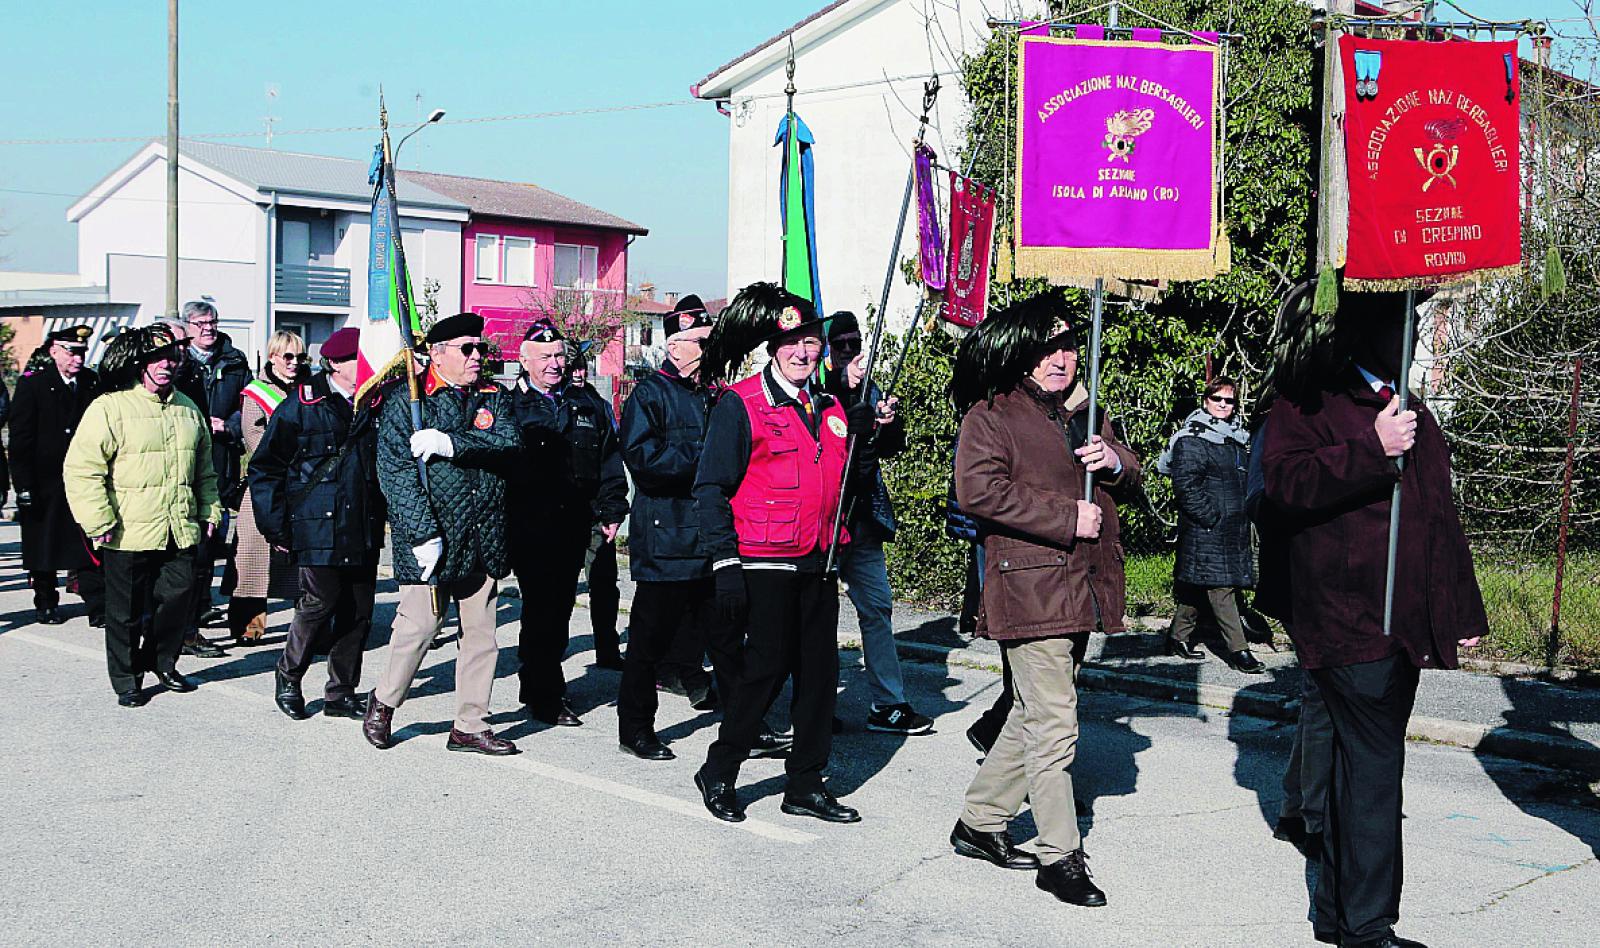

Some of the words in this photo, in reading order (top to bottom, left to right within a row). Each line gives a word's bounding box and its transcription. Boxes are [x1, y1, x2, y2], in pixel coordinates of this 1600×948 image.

[1038, 75, 1112, 123] ASSOCIAZIONE
[1140, 79, 1205, 130] BERSAGLIERI
[1367, 90, 1421, 180] ASSOCIAZIONE
[1052, 185, 1085, 199] ISOLA
[1092, 185, 1104, 199] DI
[1153, 186, 1179, 201] (RO)
[1422, 224, 1482, 244] CRESPINO
